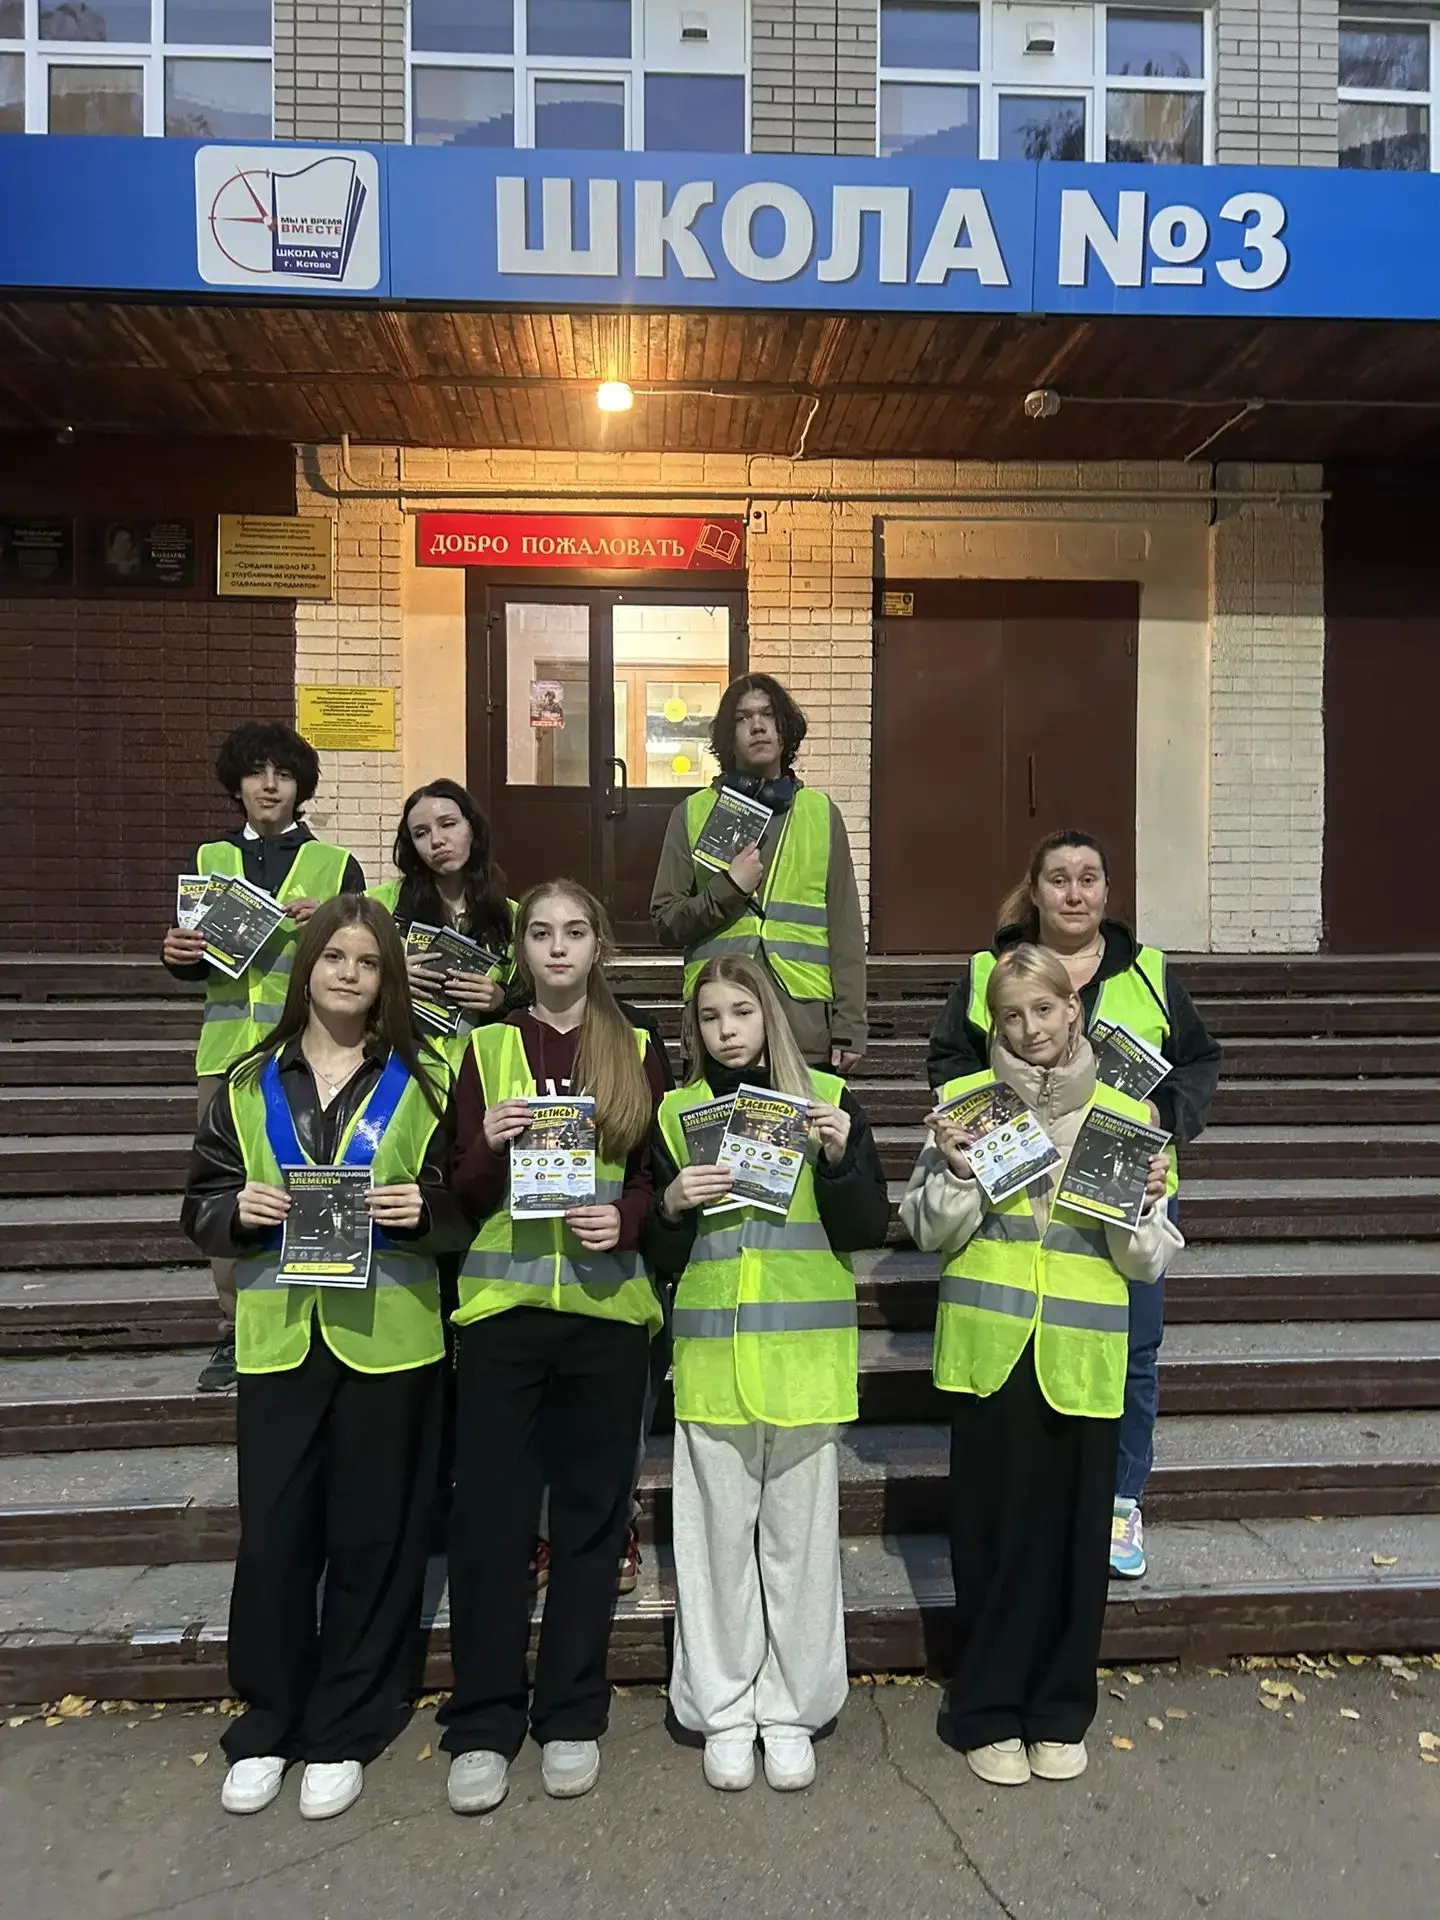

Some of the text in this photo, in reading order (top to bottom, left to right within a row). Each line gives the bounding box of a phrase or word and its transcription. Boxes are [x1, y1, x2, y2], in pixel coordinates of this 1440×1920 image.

[280, 216, 343, 226] МЫ И ВРЕМЯ
[281, 225, 342, 235] ВМЕСТЕ
[495, 175, 1289, 291] ШКОЛА №3
[276, 248, 339, 260] ШКОЛА №3
[296, 260, 332, 269] Кстово
[429, 533, 686, 558] ДОБРО ПОЖАЛОВАТЬ
[737, 1098, 795, 1117] ЗАСВЕТИСЬ!
[684, 1109, 732, 1128] ЭЛЕМЕНТЫ
[1088, 1116, 1136, 1139] ЭЛЕМЕНТЫ
[289, 1177, 341, 1185] ЭЛЕМЕНТЫ
